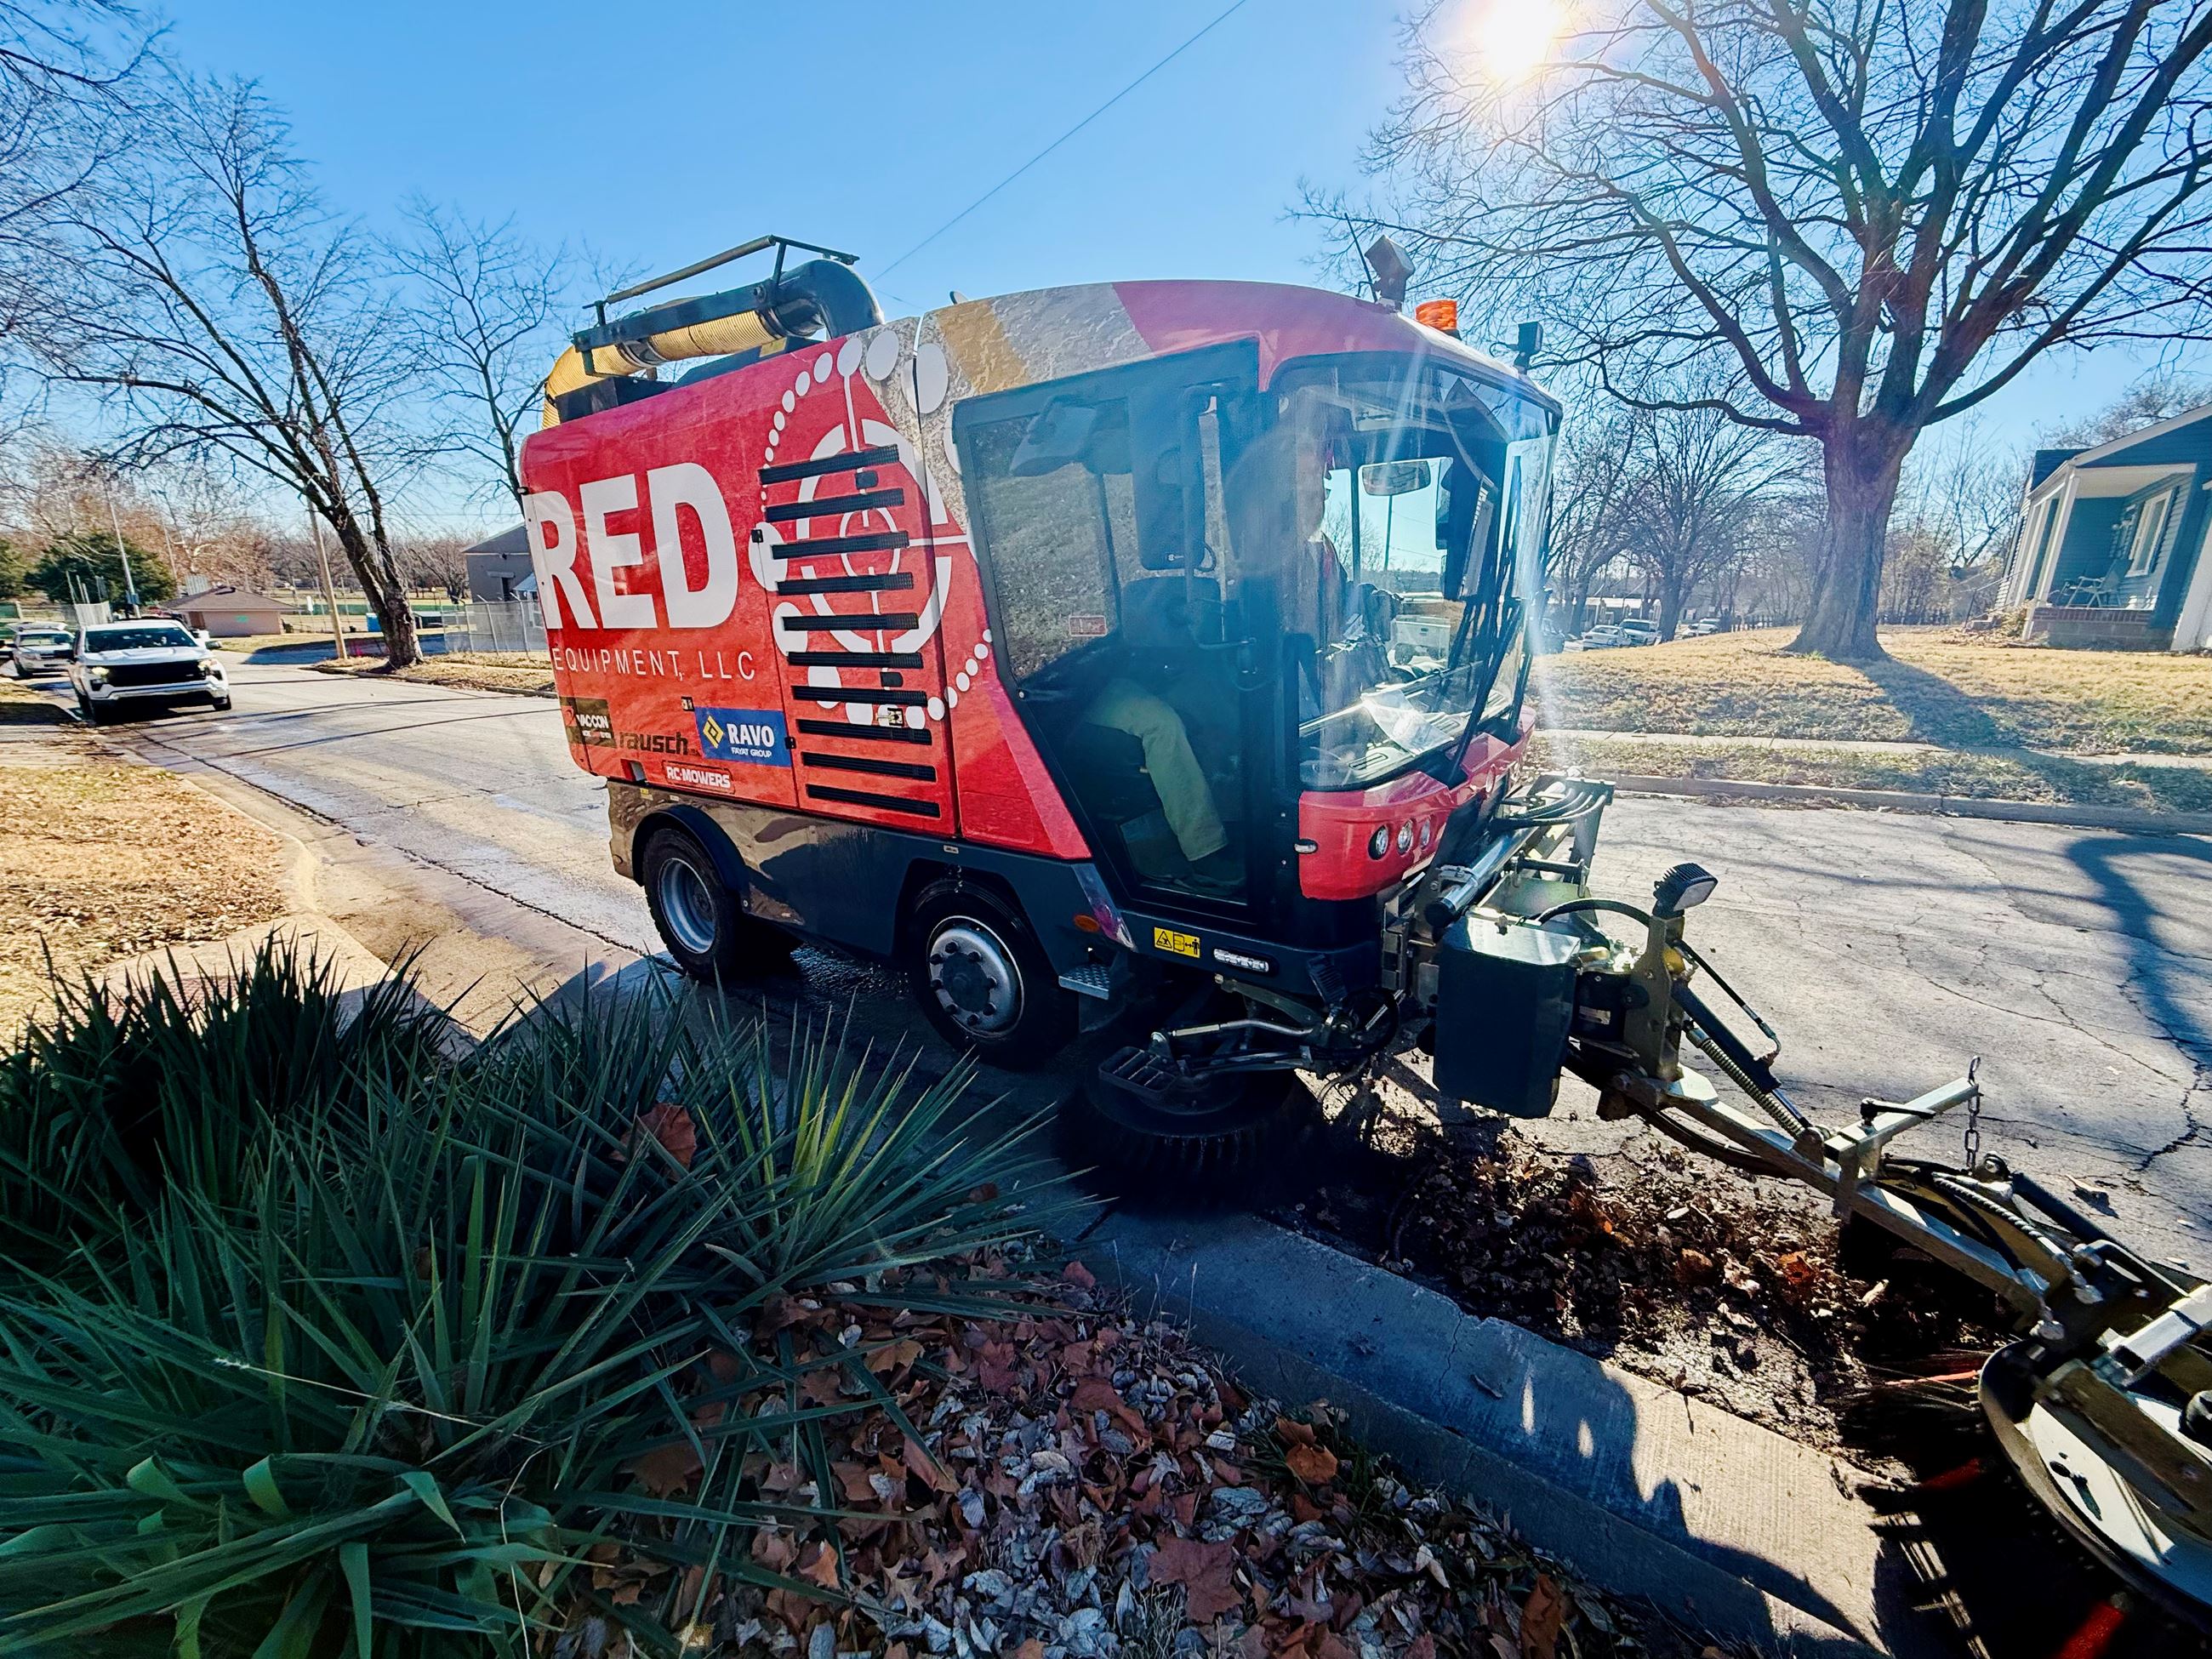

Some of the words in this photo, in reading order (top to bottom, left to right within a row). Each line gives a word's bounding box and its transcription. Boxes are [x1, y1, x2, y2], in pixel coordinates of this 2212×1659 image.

[523, 462, 738, 630] RED
[698, 651, 755, 680] LLC
[619, 732, 688, 755] rausch
[727, 723, 774, 747] RAVO
[731, 747, 749, 755] FAYAT
[750, 749, 772, 758] GROUP
